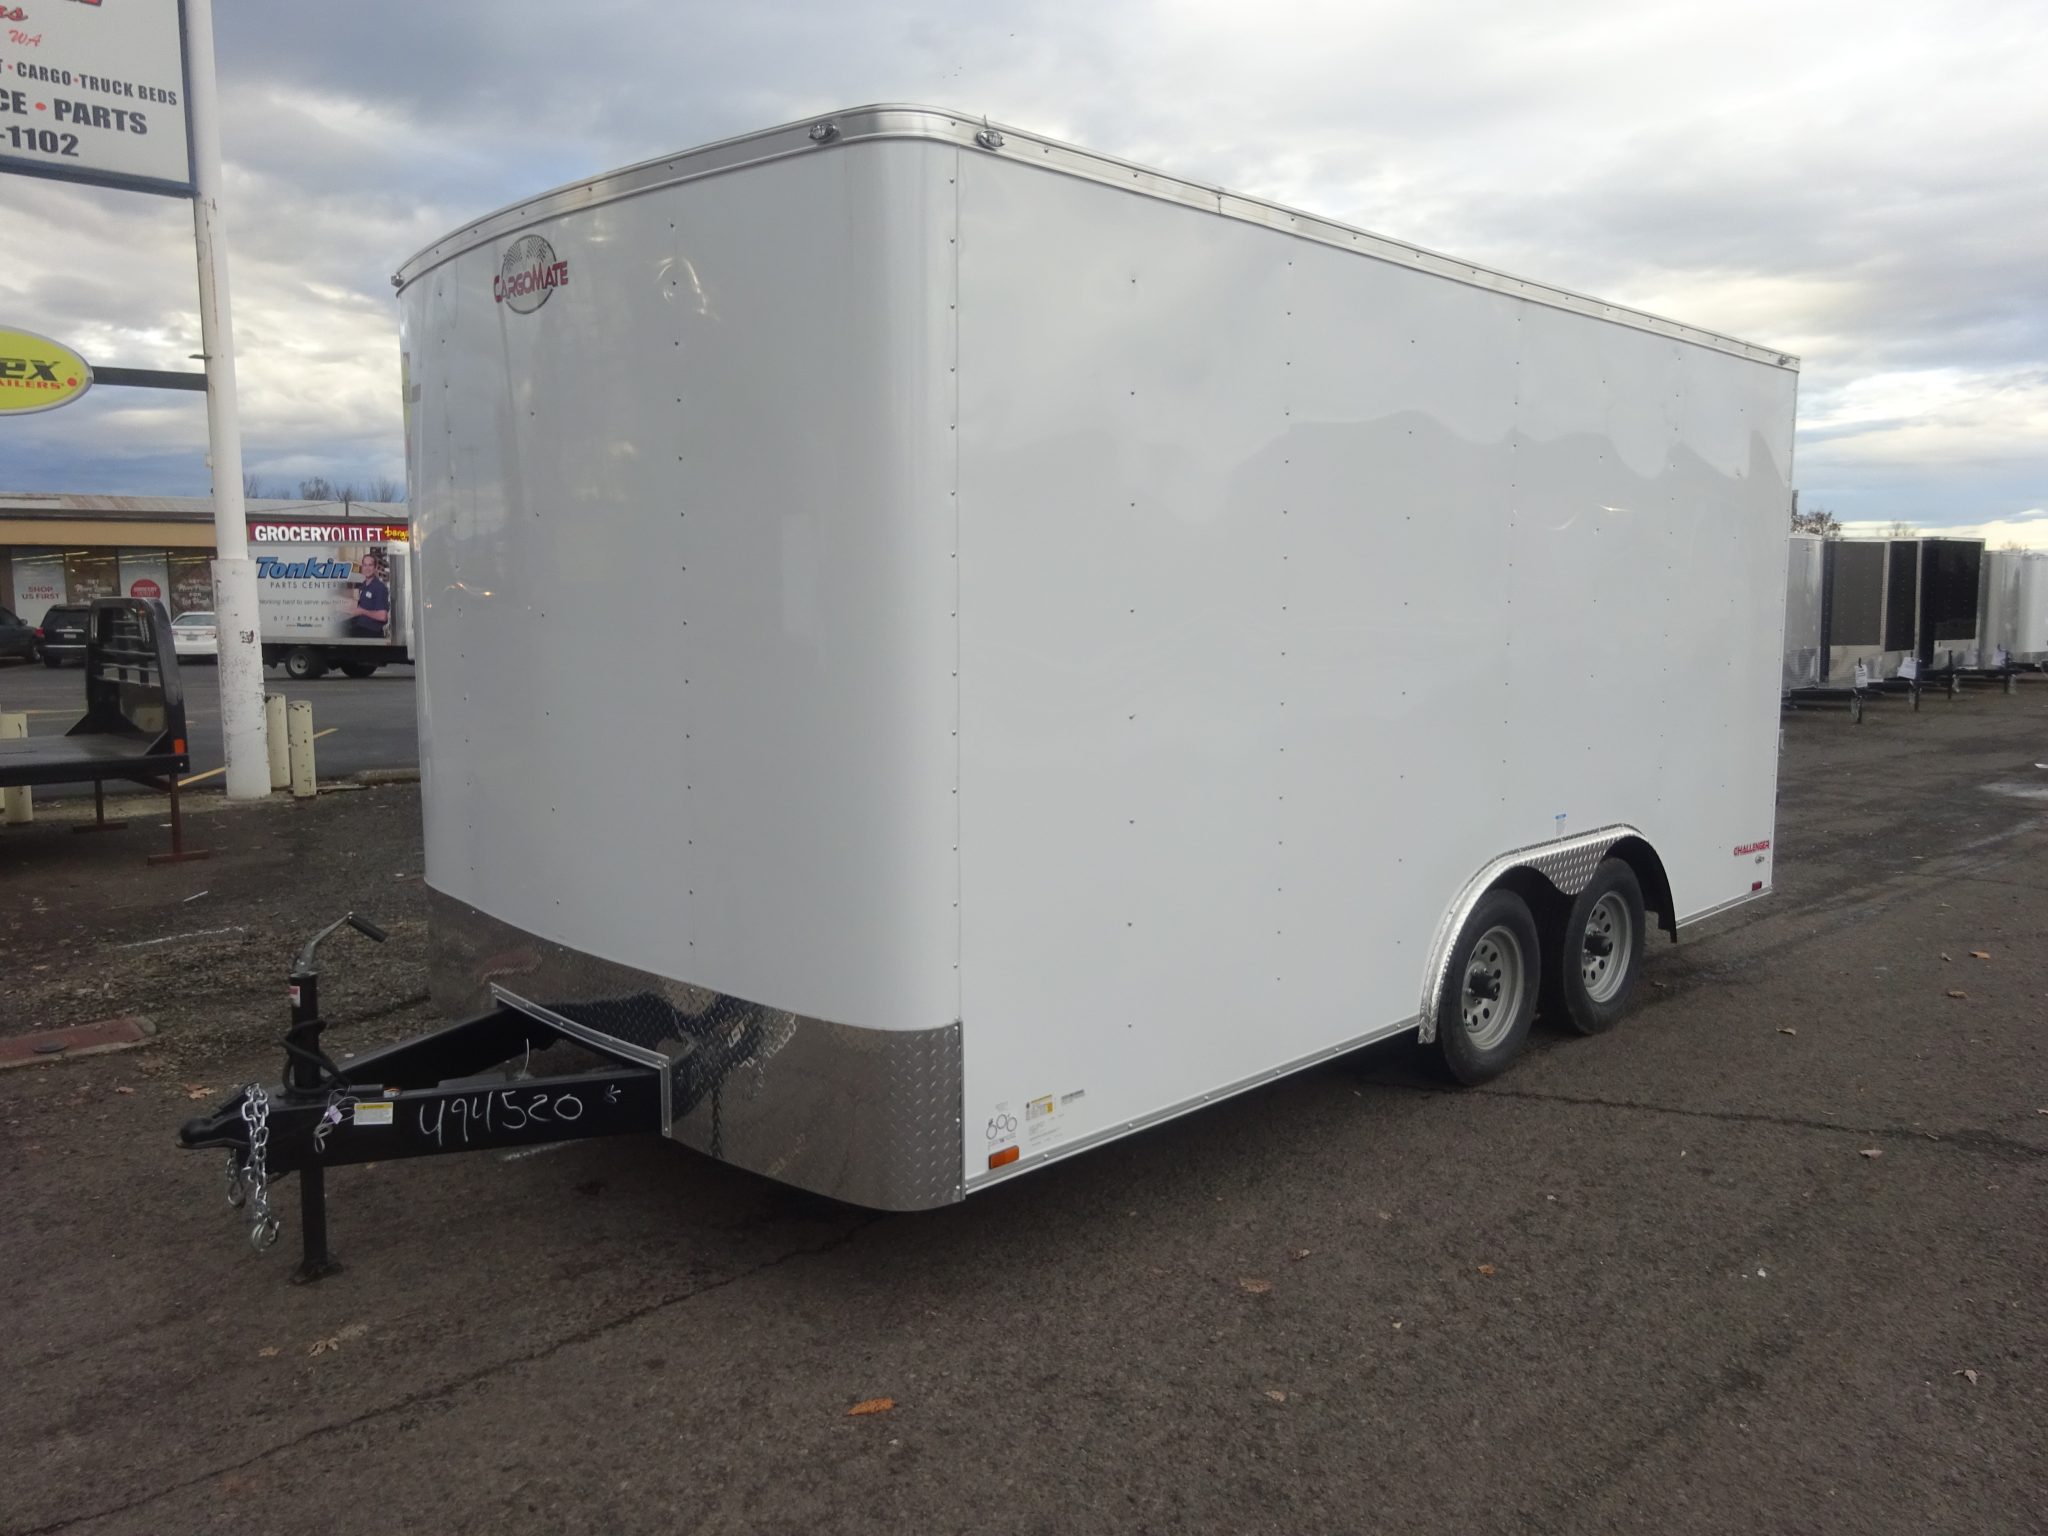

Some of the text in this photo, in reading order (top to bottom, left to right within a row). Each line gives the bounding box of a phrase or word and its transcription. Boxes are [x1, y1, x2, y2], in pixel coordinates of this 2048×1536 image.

[9, 29, 42, 47] WA
[17, 61, 72, 86] CARGO
[78, 73, 134, 98] TRUCK
[137, 84, 178, 106] BEDS
[53, 98, 148, 135] PARTS
[493, 260, 569, 303] CARGOMATE
[255, 556, 353, 580] Tonkin
[270, 581, 337, 589] PARTS CENTER
[1733, 840, 1770, 856] CHALLENGER
[419, 1091, 583, 1146] 494520
